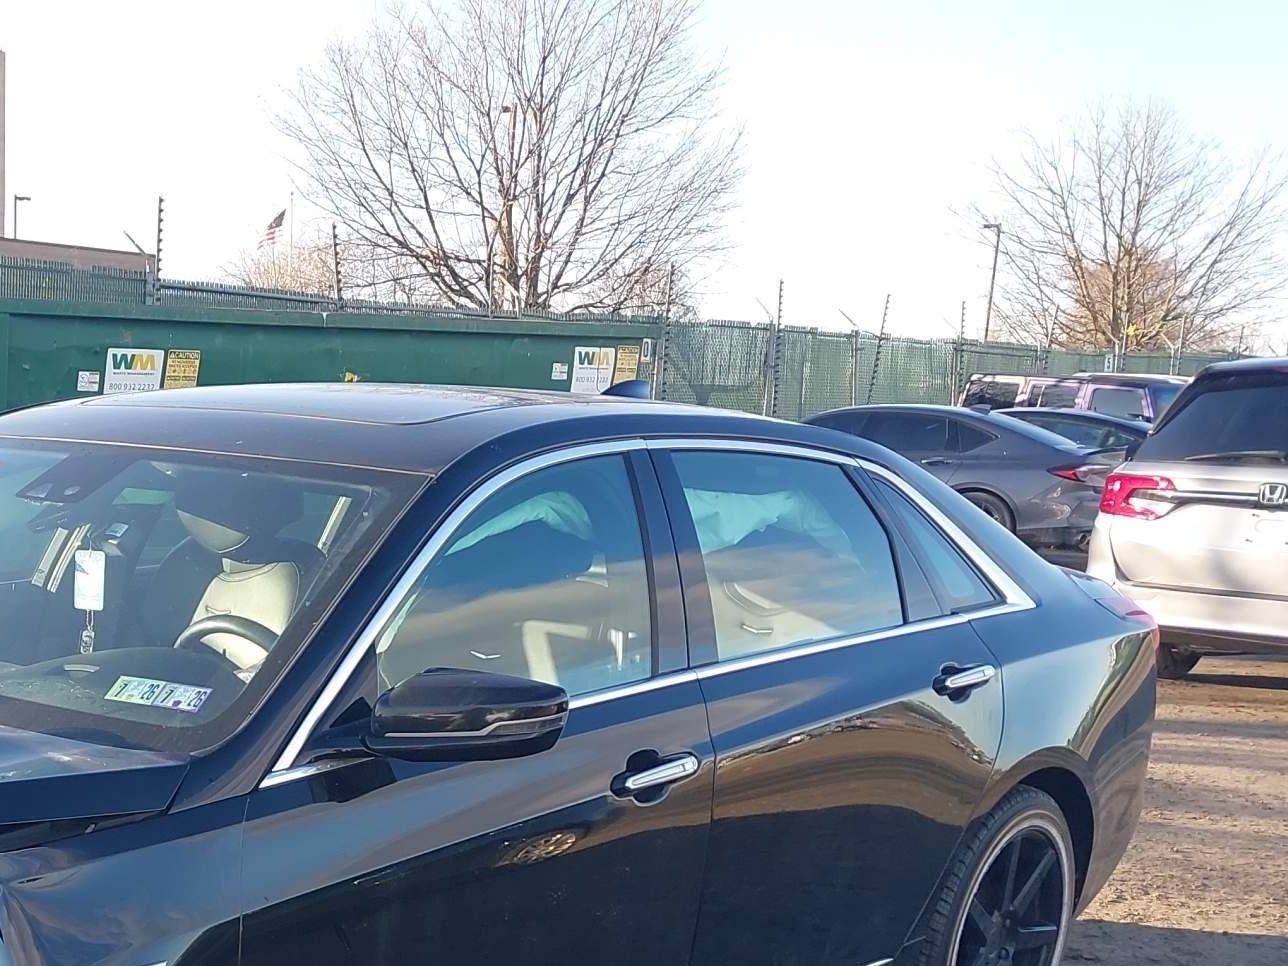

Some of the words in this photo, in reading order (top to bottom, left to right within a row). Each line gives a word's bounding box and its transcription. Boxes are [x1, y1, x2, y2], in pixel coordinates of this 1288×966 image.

[112, 353, 156, 371] WM
[174, 351, 199, 361] CAUTION
[108, 382, 123, 391] 800
[123, 383, 136, 391] 932
[114, 683, 128, 698] 7
[140, 683, 160, 701] 26
[160, 689, 175, 704] 7
[187, 690, 208, 708] 26
